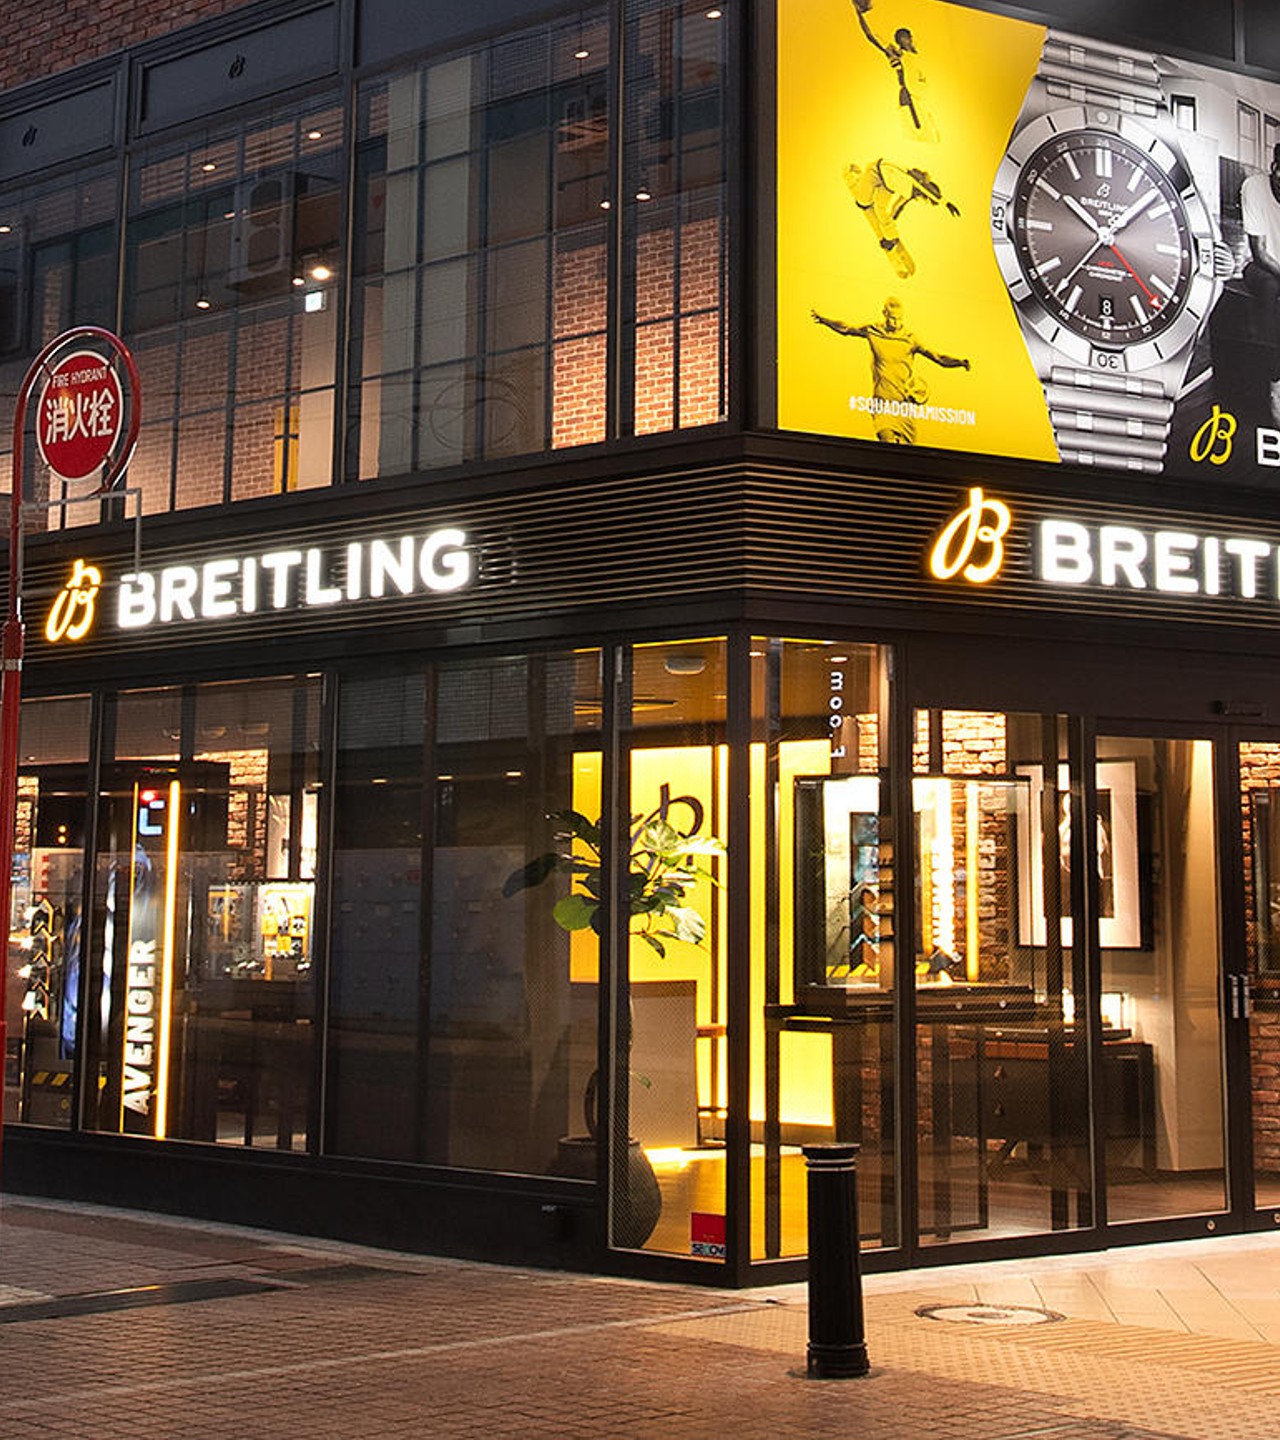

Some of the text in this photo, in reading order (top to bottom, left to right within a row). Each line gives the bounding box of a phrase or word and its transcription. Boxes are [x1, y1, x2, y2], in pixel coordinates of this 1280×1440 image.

[992, 206, 1005, 231] 45
[1200, 248, 1212, 266] 15
[1096, 353, 1120, 369] 30
[51, 366, 108, 389] FIRE HYDRANT
[44, 387, 116, 446] 消火栓
[848, 395, 978, 426] #SQUADONAMISSION
[116, 528, 471, 629] BREITLING
[122, 938, 158, 1115] AVENGER
